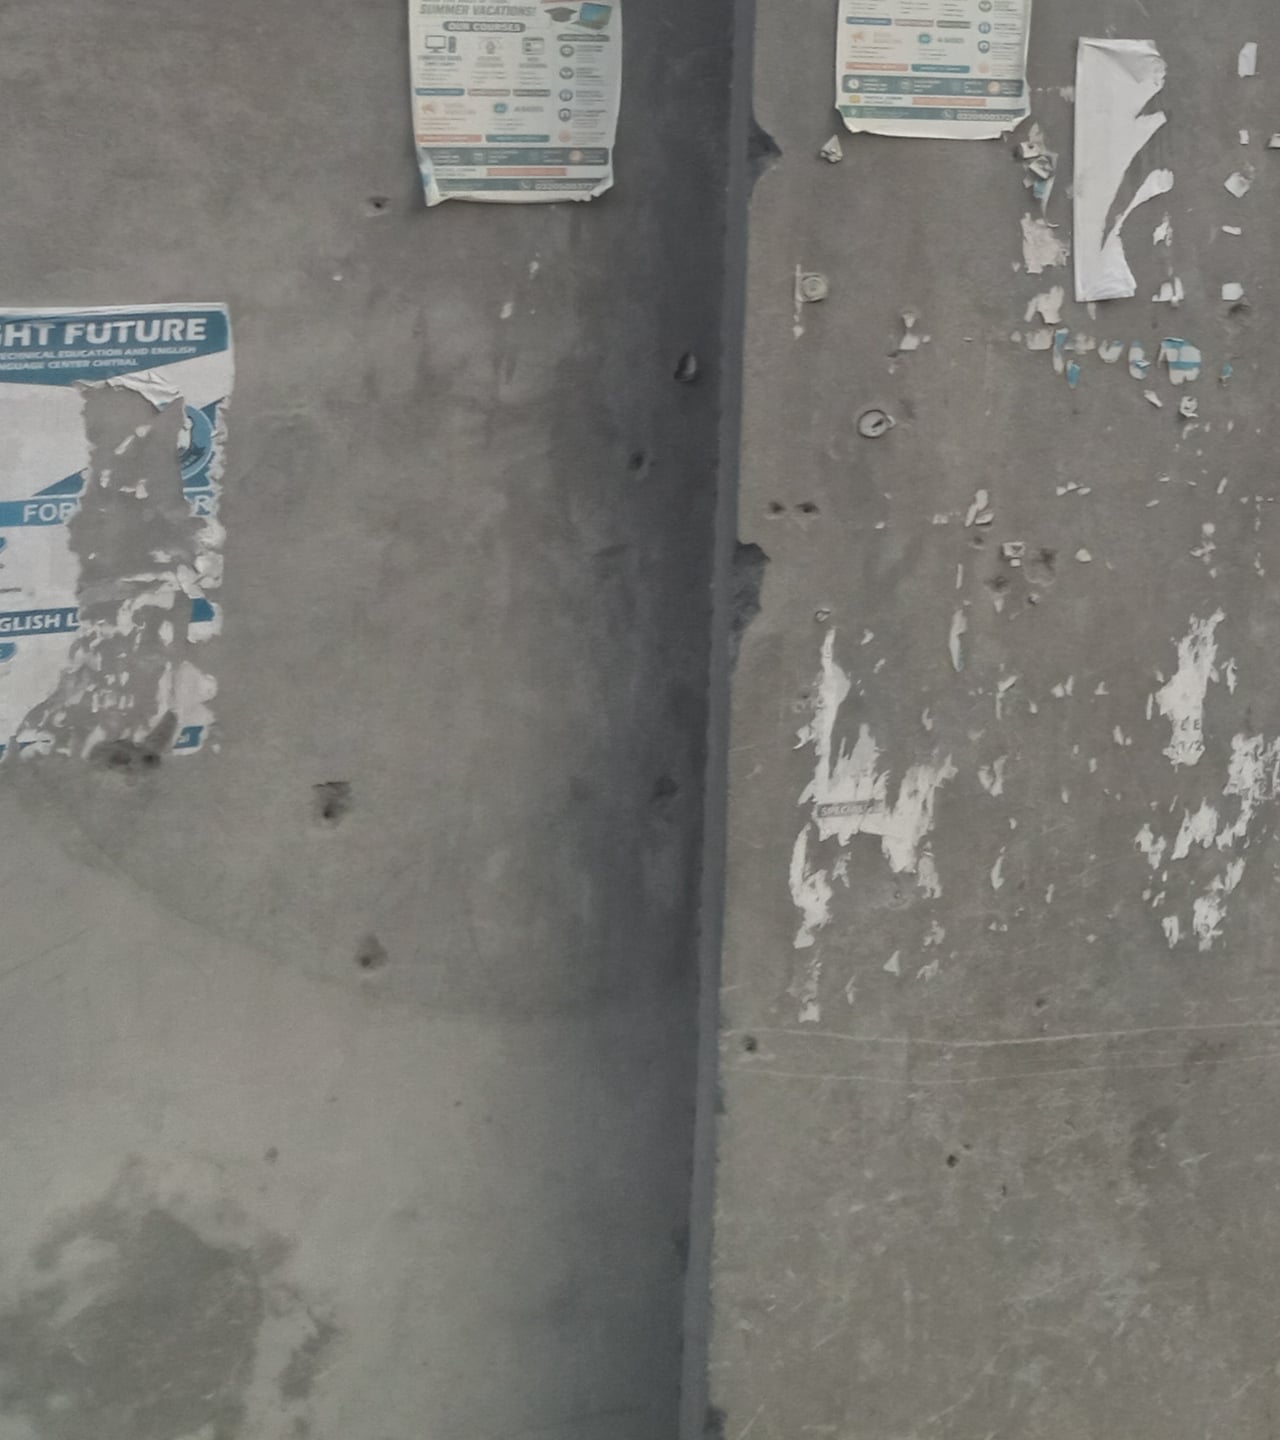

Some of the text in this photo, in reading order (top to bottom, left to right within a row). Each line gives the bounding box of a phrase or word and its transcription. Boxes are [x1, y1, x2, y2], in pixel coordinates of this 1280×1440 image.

[419, 3, 469, 15] SUMMER
[0, 317, 207, 347] HT FUTURE
[124, 347, 149, 356] AND
[151, 345, 197, 355] ENGLISH
[47, 360, 90, 369] CENTER
